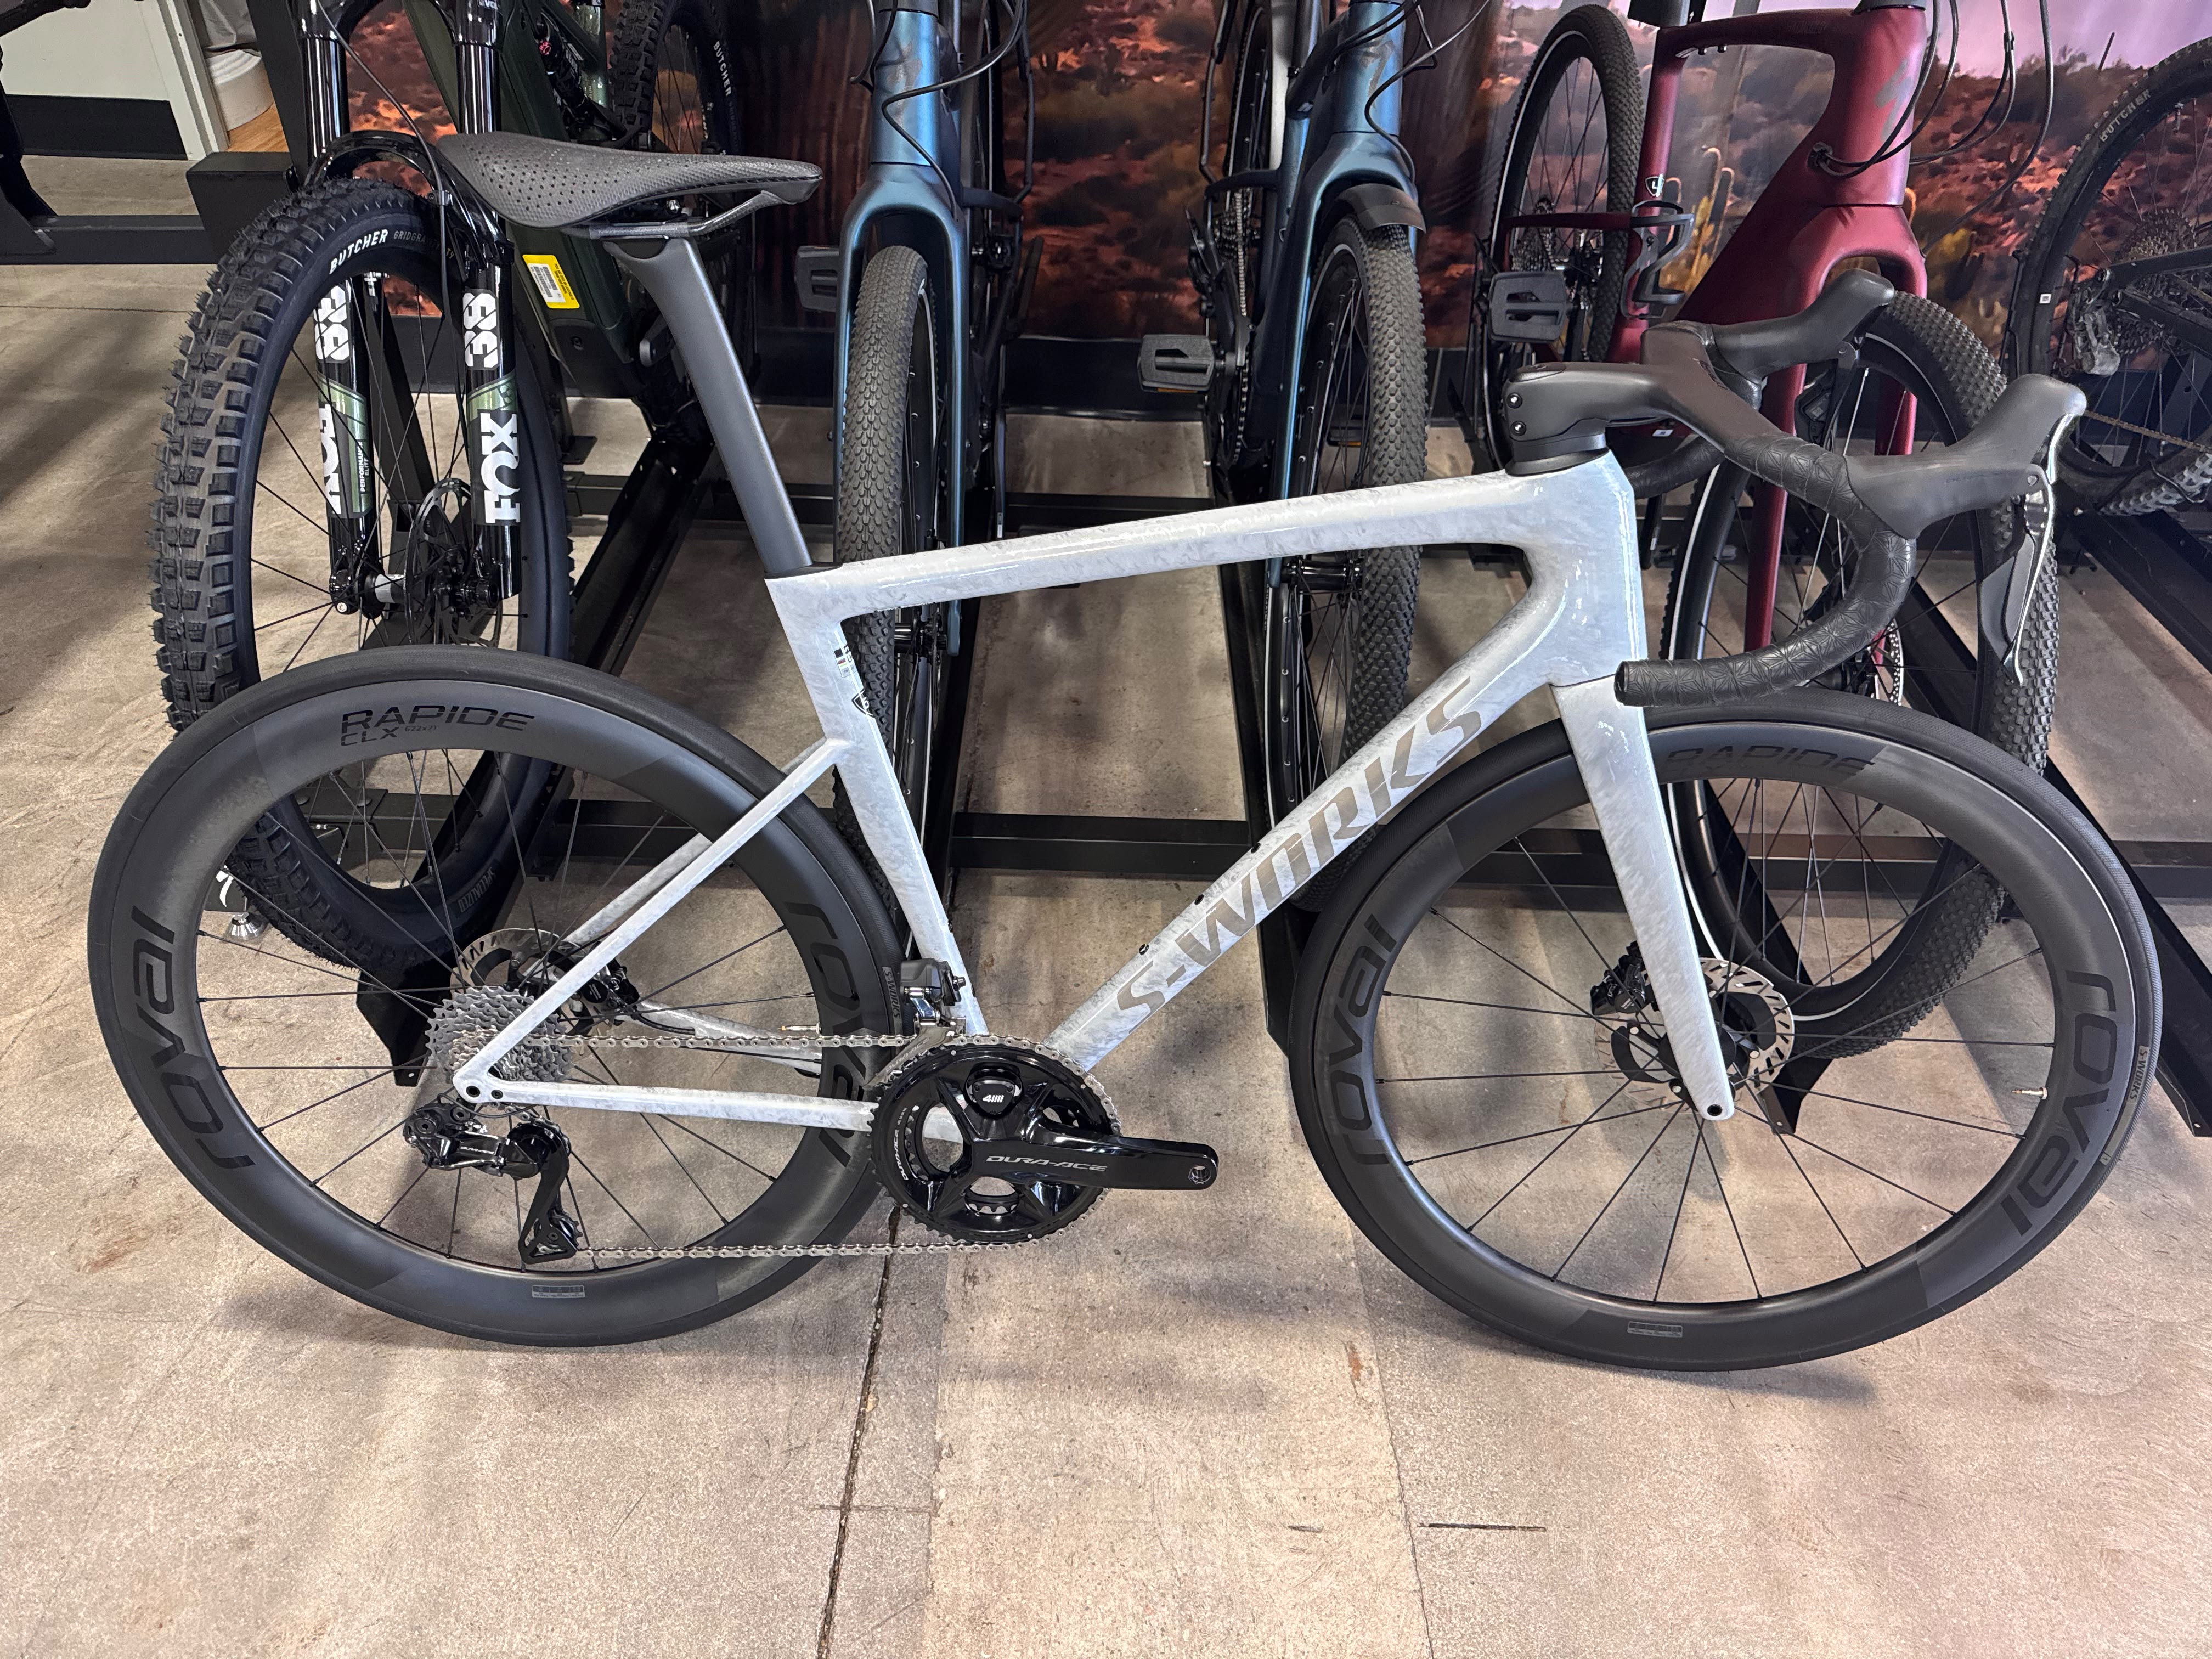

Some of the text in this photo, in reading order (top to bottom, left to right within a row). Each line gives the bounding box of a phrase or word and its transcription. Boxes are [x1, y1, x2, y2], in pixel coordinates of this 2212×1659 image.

[713, 41, 731, 97] BUTCHER
[329, 229, 388, 275] BUTCHER
[462, 292, 498, 368] 38
[358, 439, 366, 492] PERFORMANCE
[480, 413, 521, 524] FOX
[341, 705, 535, 733] RAPIDE
[341, 727, 399, 747] CLX
[1666, 745, 1875, 776] RAPIDE
[1117, 677, 1481, 1034] S-WORKS
[884, 970, 900, 1019] S-WORKS
[2130, 1049, 2148, 1100] S-WORKS
[894, 1130, 909, 1180] DURA-ACE
[986, 1156, 1108, 1172] DURA-ACE
